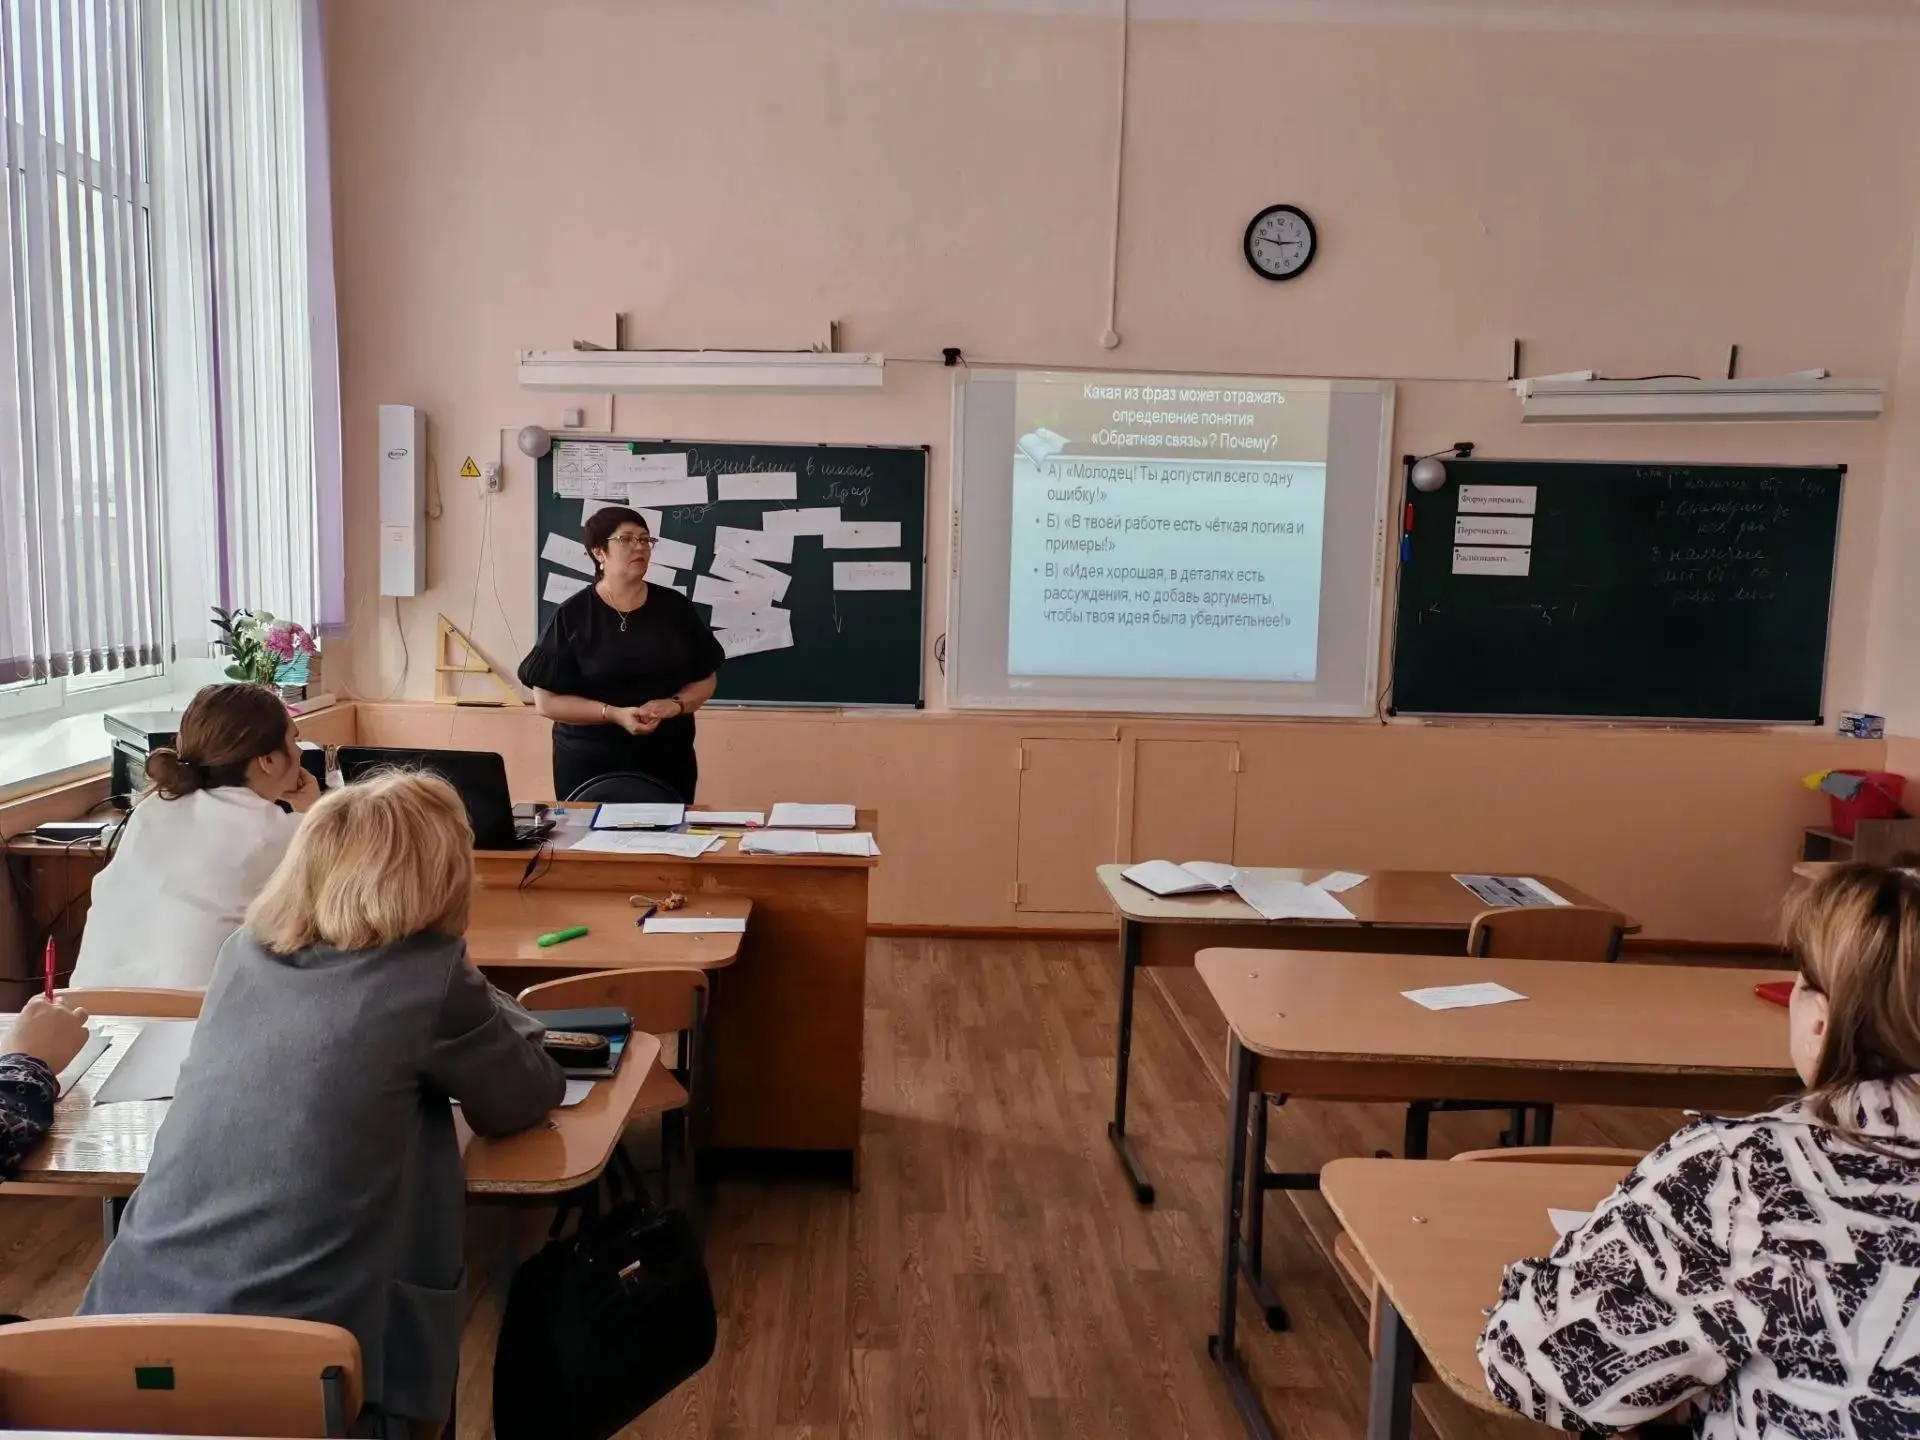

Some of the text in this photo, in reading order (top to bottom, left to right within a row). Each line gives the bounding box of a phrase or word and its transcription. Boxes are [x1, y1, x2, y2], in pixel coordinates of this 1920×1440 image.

[1083, 383, 1286, 406] Какая из фраз может отражать
[1113, 410, 1254, 426] определение понятия
[1091, 430, 1278, 453] «Обратная связь»? Почему?
[1048, 464, 1293, 487] А) «Молодец! Ты допустил всего одну
[1047, 486, 1107, 503] ошибку!»
[1047, 514, 1060, 529] Б)
[1064, 514, 1081, 529] «В
[1083, 513, 1121, 531] твоей
[1124, 514, 1171, 534] работе
[1173, 520, 1202, 532] есть
[1251, 520, 1295, 536] логика
[1296, 523, 1304, 535] и
[1046, 536, 1116, 555] примеры!»
[1045, 562, 1265, 583] В) «Идея хорошая, в деталях есть
[1044, 587, 1275, 610] рассуждения, но добавь аргументы,
[1043, 607, 1291, 629] чтобы твоя идея была убедительнее!»
